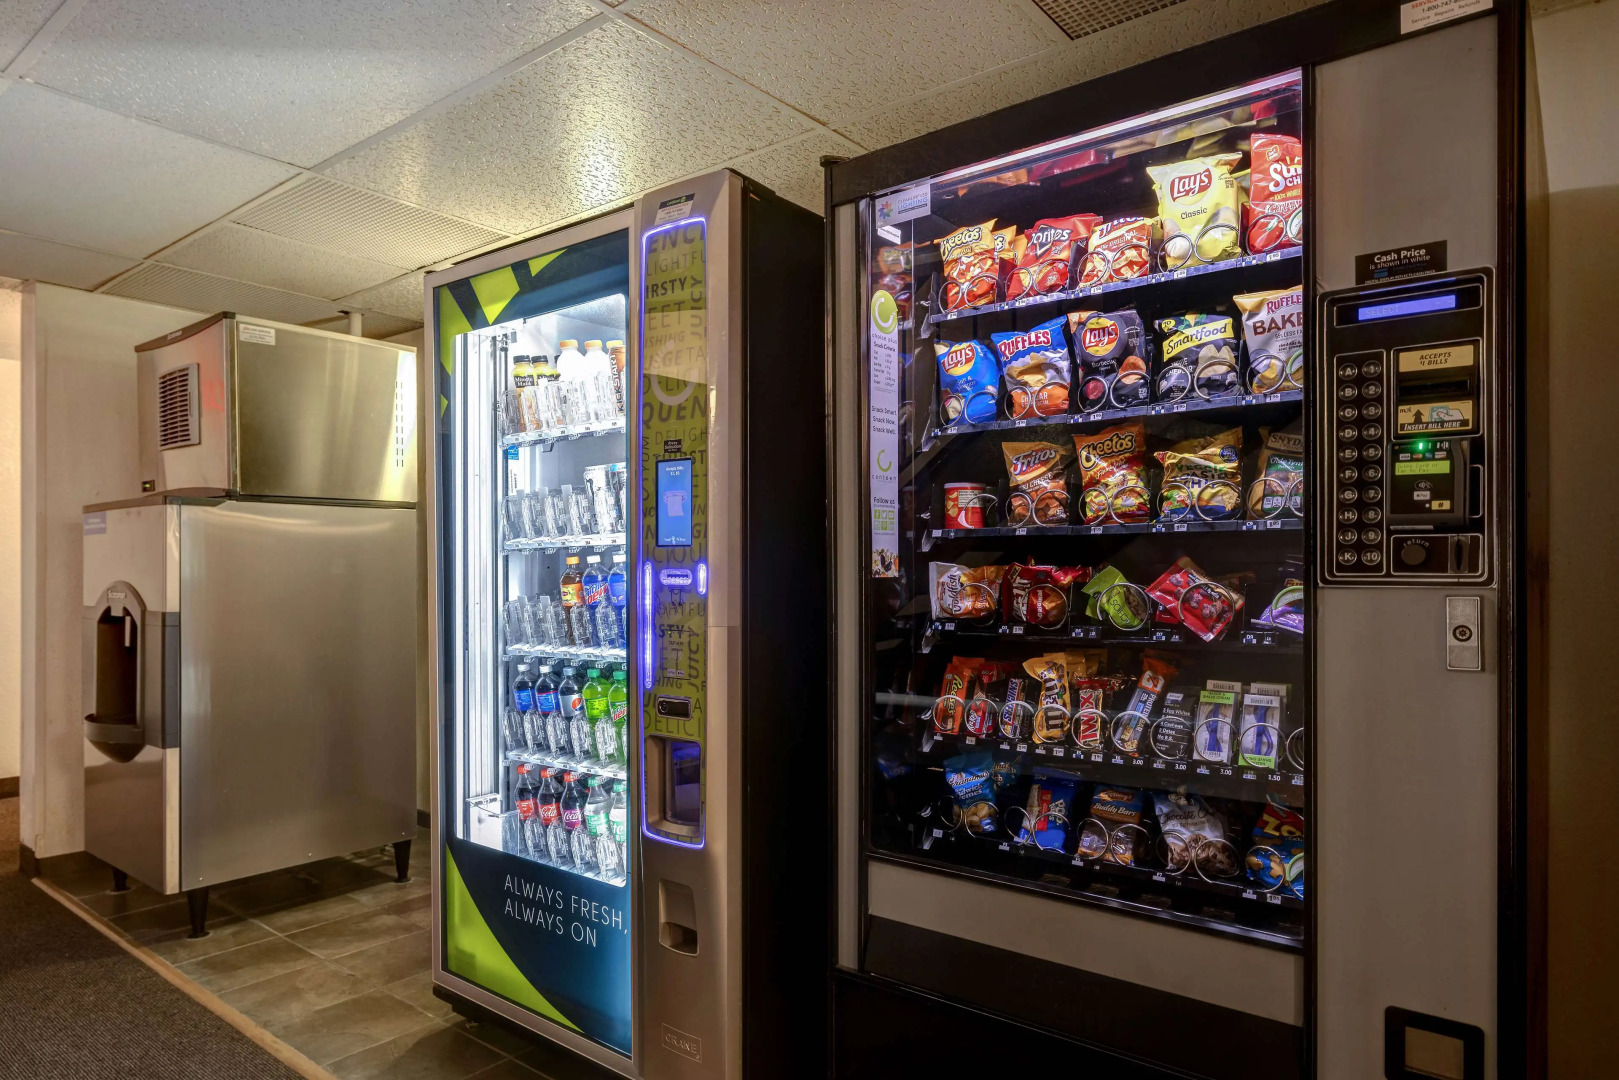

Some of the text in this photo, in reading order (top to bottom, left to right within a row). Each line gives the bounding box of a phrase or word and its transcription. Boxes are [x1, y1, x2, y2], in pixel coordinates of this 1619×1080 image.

[1180, 207, 1208, 220] Classic
[1374, 248, 1426, 263] Cash Price
[1377, 260, 1400, 268] shown
[1410, 254, 1430, 263] white
[1366, 305, 1400, 316] SELECT
[1085, 325, 1116, 347] Lay's
[1166, 322, 1228, 355] Smartfood
[998, 330, 1051, 360] RUFFLES
[942, 346, 974, 370] Lay's
[1419, 351, 1452, 360] ACCEPTS
[1092, 359, 1116, 367] Barbecue
[1345, 368, 1352, 376] A
[1345, 388, 1352, 396] B
[1369, 407, 1375, 415] 3
[873, 415, 885, 423] Snack
[873, 425, 885, 434] Snack
[1345, 429, 1352, 437] D
[1368, 428, 1375, 436] 4
[1080, 432, 1135, 470] Cheetos
[1012, 448, 1058, 475] Fritos
[1344, 491, 1353, 499] G
[1403, 538, 1430, 548] return
[946, 574, 962, 614] Goldfish
[1080, 692, 1098, 740] TWIX
[1221, 767, 1231, 775] 3.00
[1093, 802, 1136, 816] Buddy Bars
[504, 874, 627, 934] ALWAYS FRESH,
[504, 898, 596, 947] ALWAYS ON
[665, 1033, 697, 1054] CRANE
